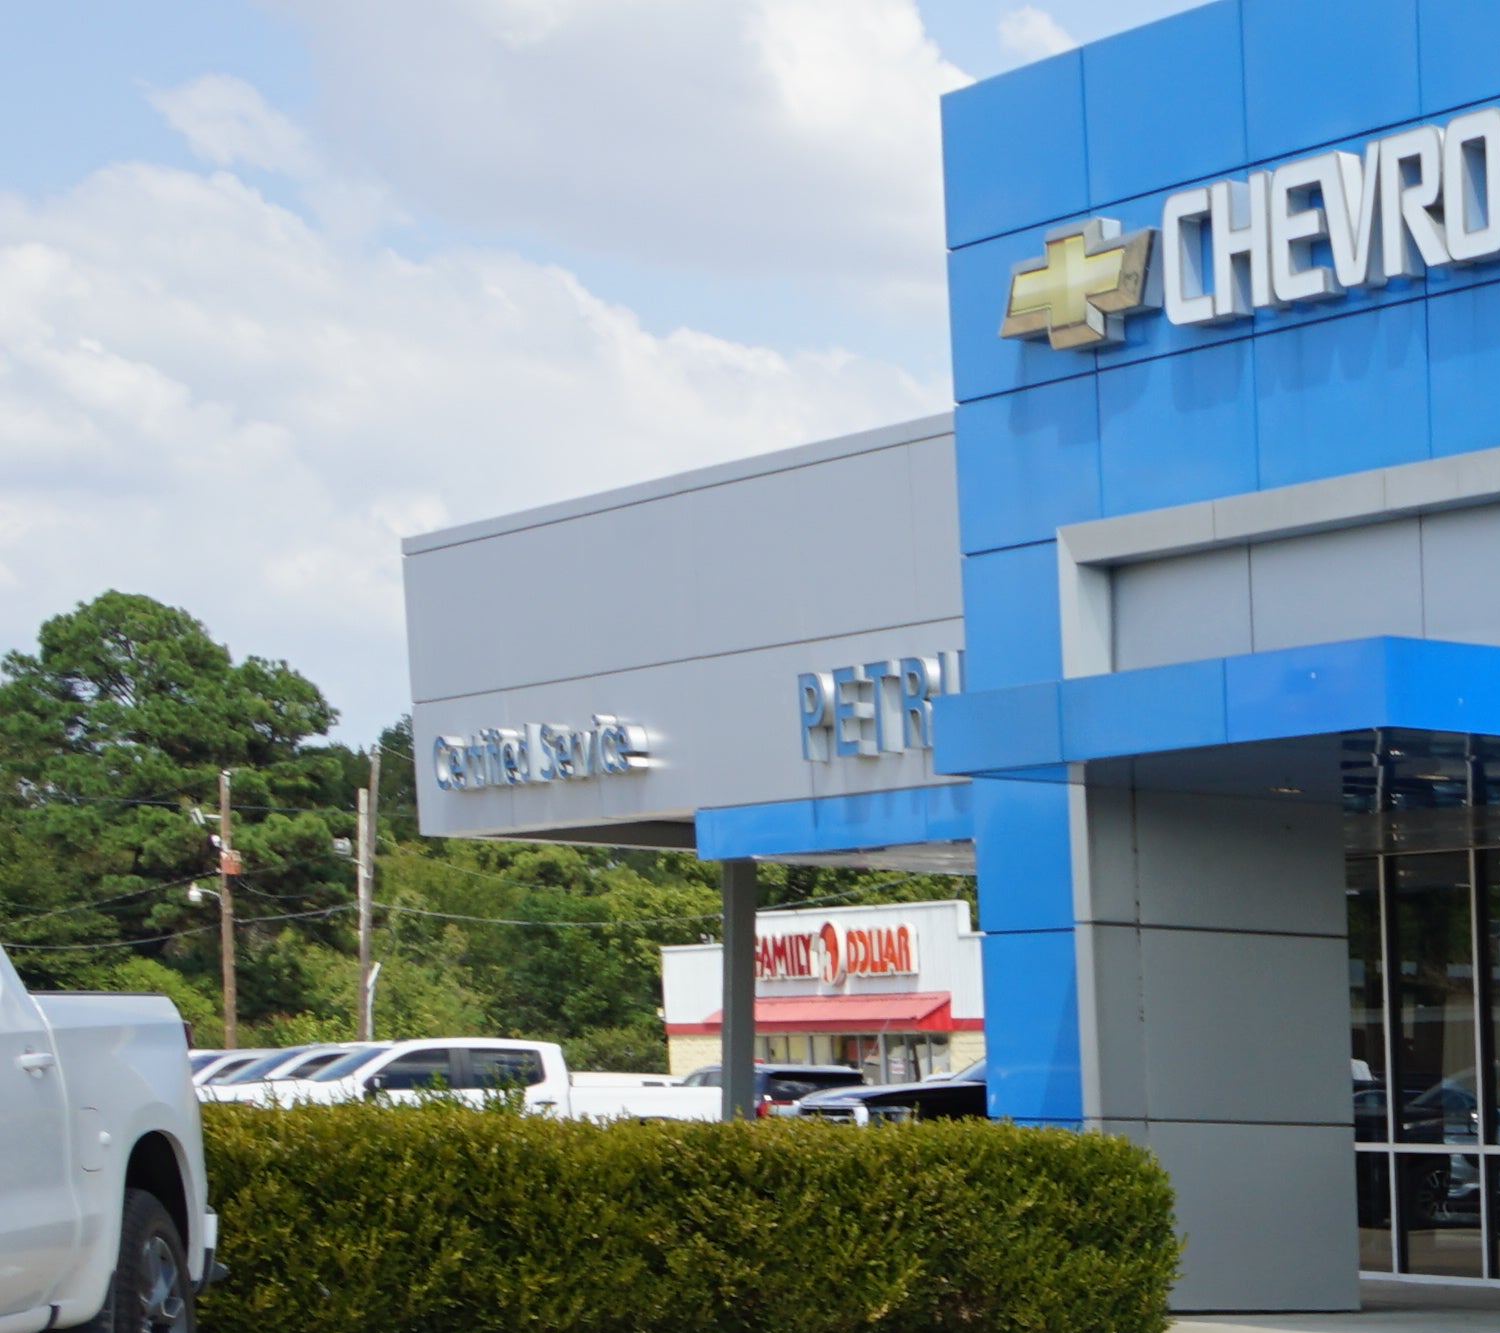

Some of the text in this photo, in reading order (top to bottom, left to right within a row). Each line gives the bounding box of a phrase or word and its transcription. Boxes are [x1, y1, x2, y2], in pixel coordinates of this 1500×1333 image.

[434, 713, 650, 791] Certified Service
[846, 925, 913, 975] DOLLAR
